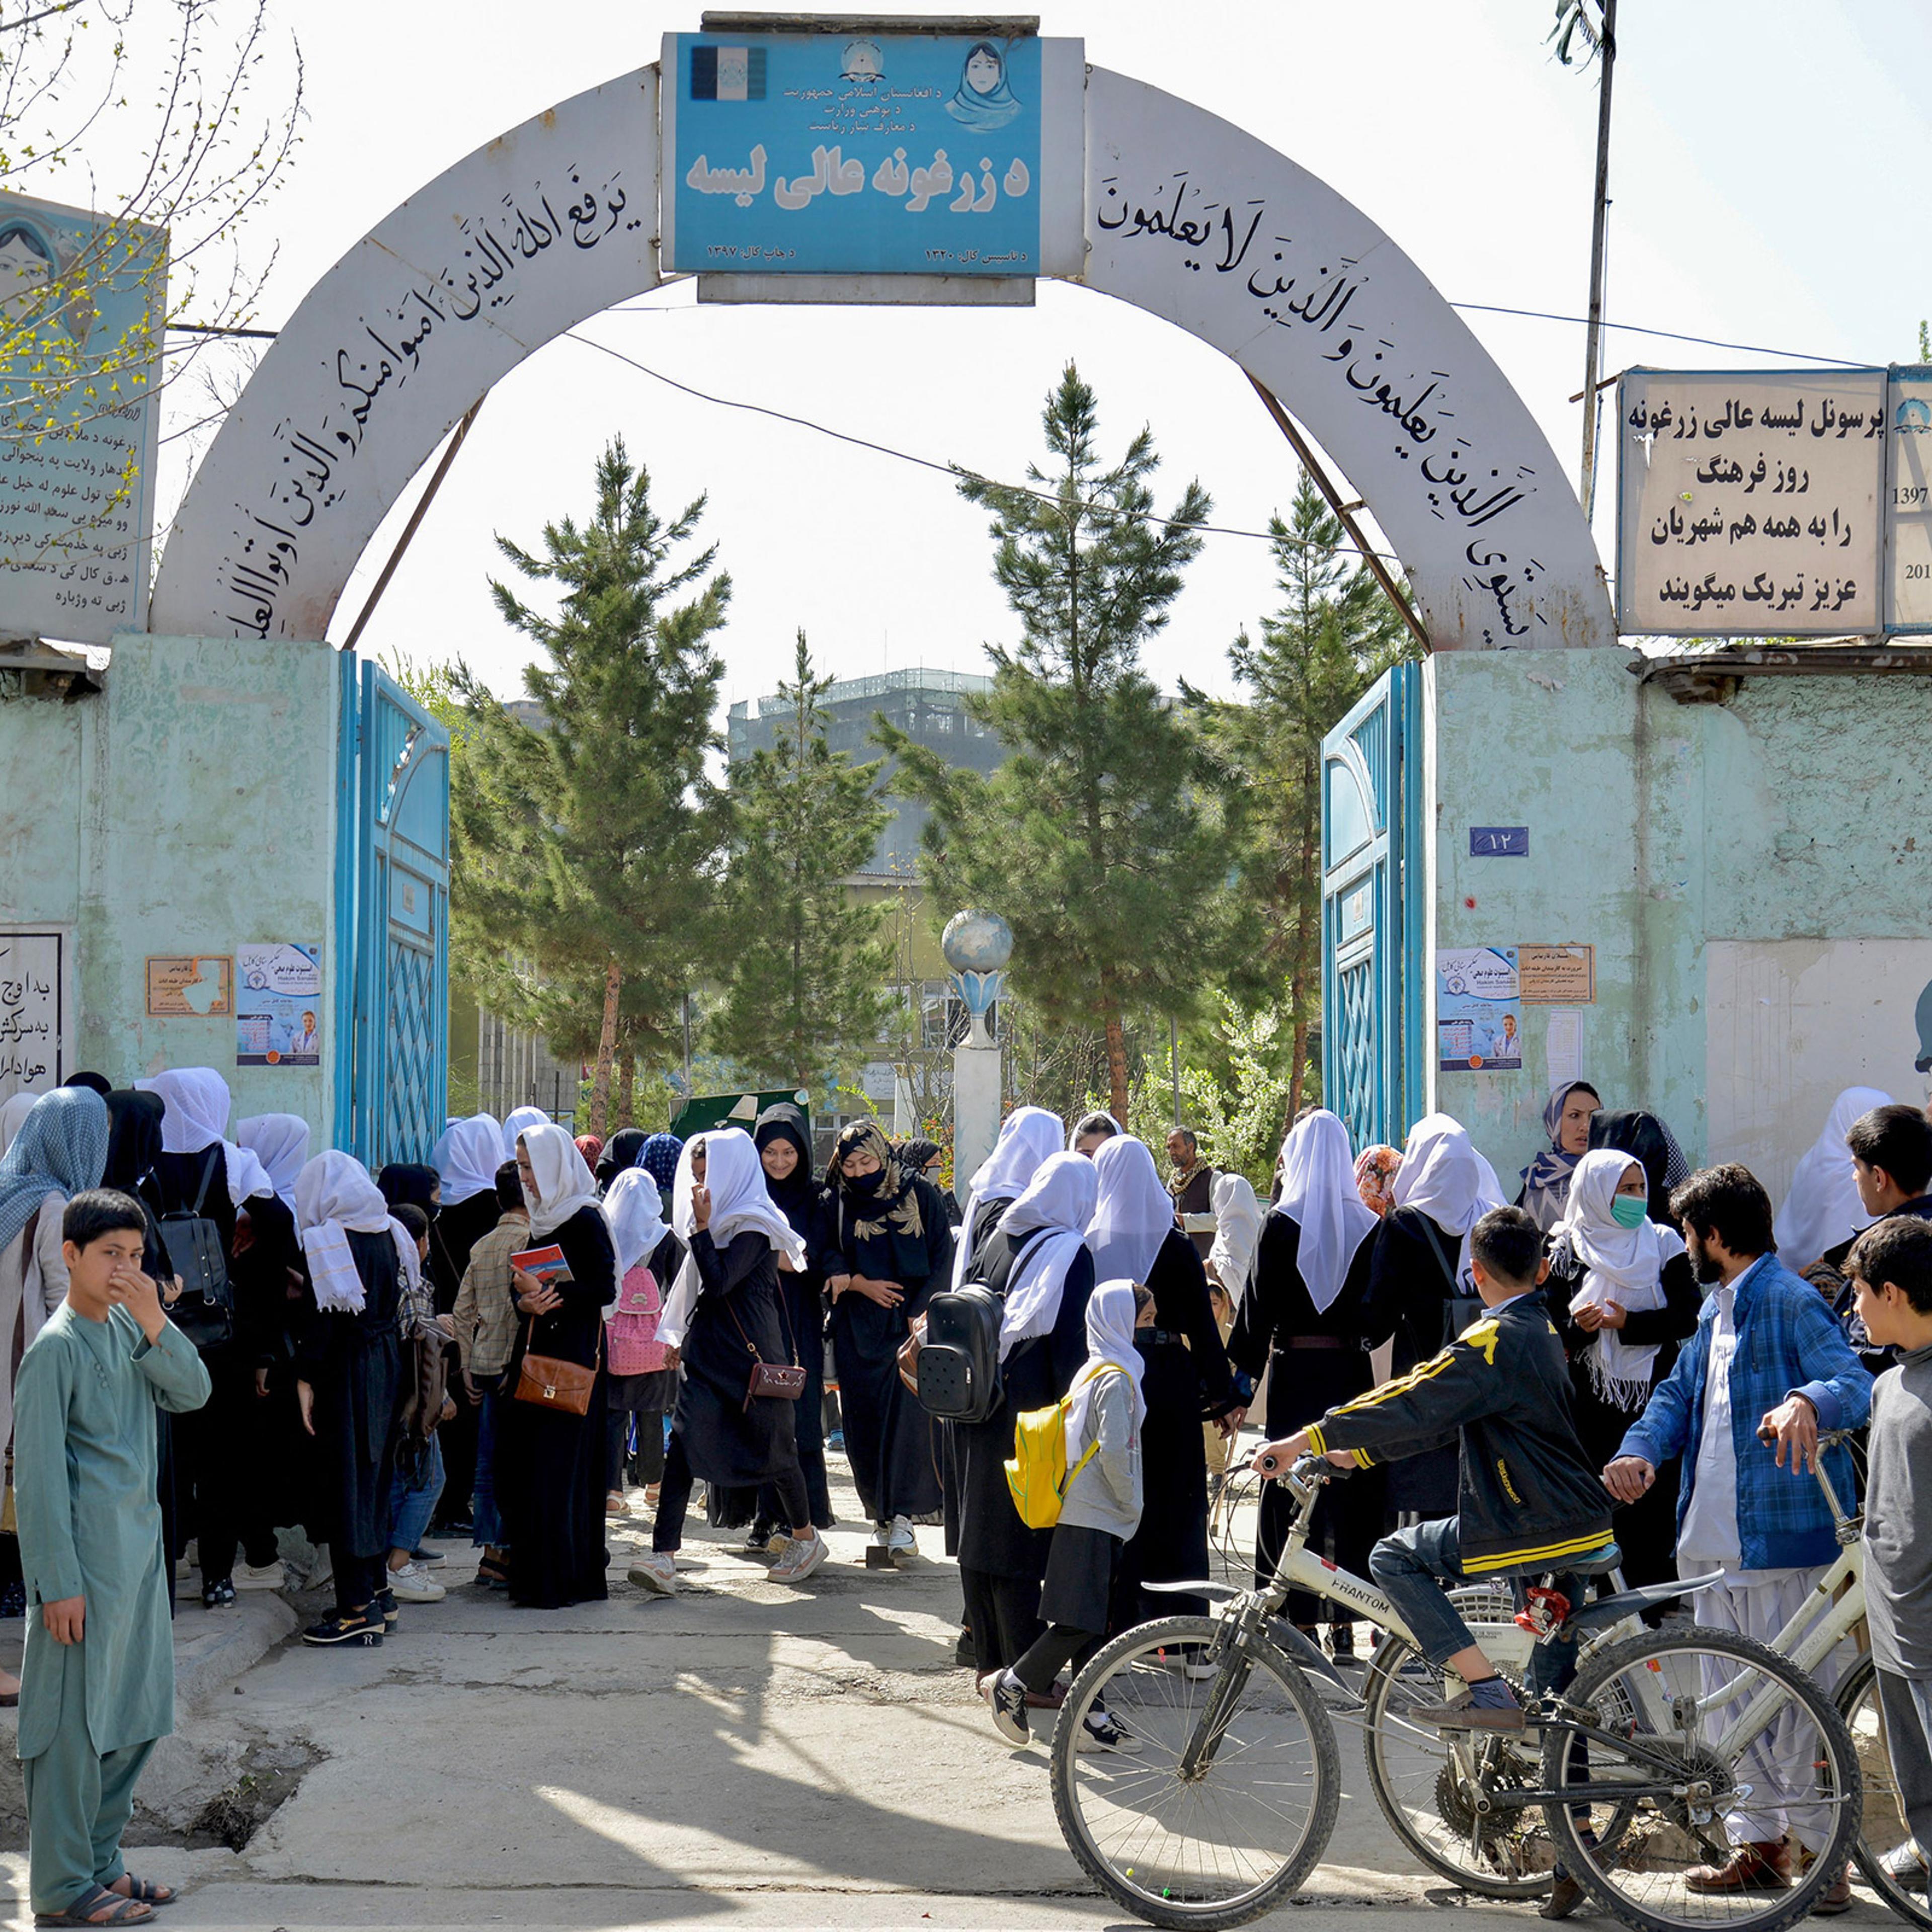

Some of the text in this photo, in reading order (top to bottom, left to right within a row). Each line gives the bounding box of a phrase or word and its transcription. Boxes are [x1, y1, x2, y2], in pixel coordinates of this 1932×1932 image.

[686, 143, 767, 207] لیسه
[872, 147, 997, 212] زرغونه
[1004, 157, 1029, 197] د
[1629, 399, 1885, 439] پرسونل لیسه عالی زرغونه
[13, 475, 34, 493] خپل
[52, 484, 77, 499] علوم
[1697, 452, 1809, 493] روز فرهنگ
[24, 502, 41, 513] الله
[1892, 487, 1928, 504] 1397
[1651, 507, 1852, 546] را به همه هم شهریان
[80, 567, 100, 581] کال
[1659, 572, 1858, 611] عزیز تبریک میگویند
[1490, 834, 1511, 850] ۱۲
